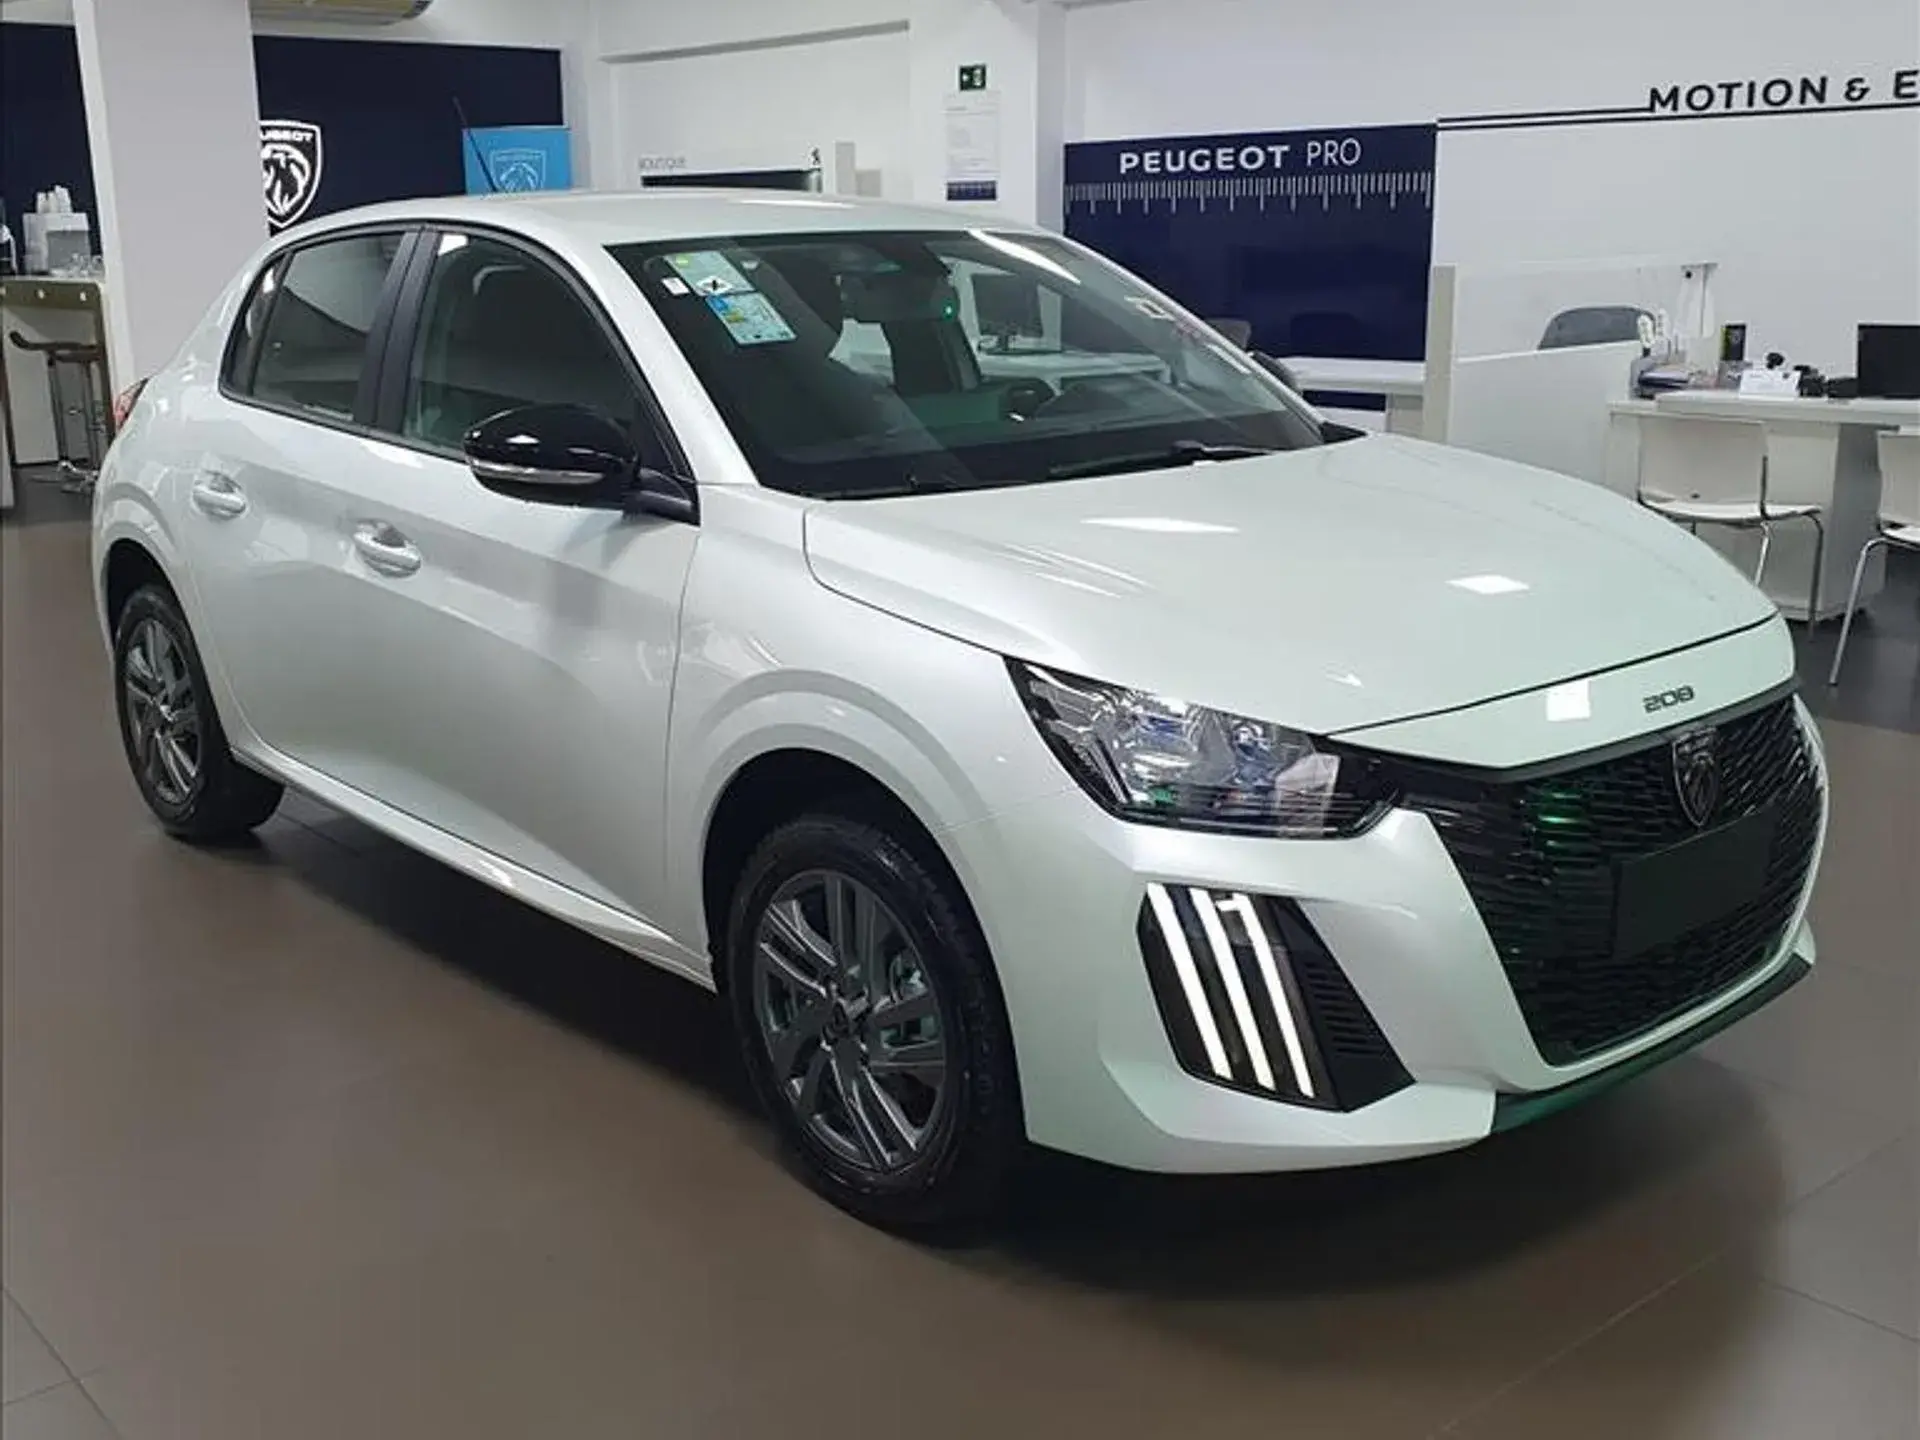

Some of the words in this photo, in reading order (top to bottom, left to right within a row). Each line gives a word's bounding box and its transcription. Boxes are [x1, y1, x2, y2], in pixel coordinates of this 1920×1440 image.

[1650, 76, 1828, 113] MOTION
[1844, 77, 1871, 101] &
[1119, 145, 1290, 174] PEUGEOT
[1306, 138, 1362, 167] PRO
[1643, 685, 1694, 713] 208
